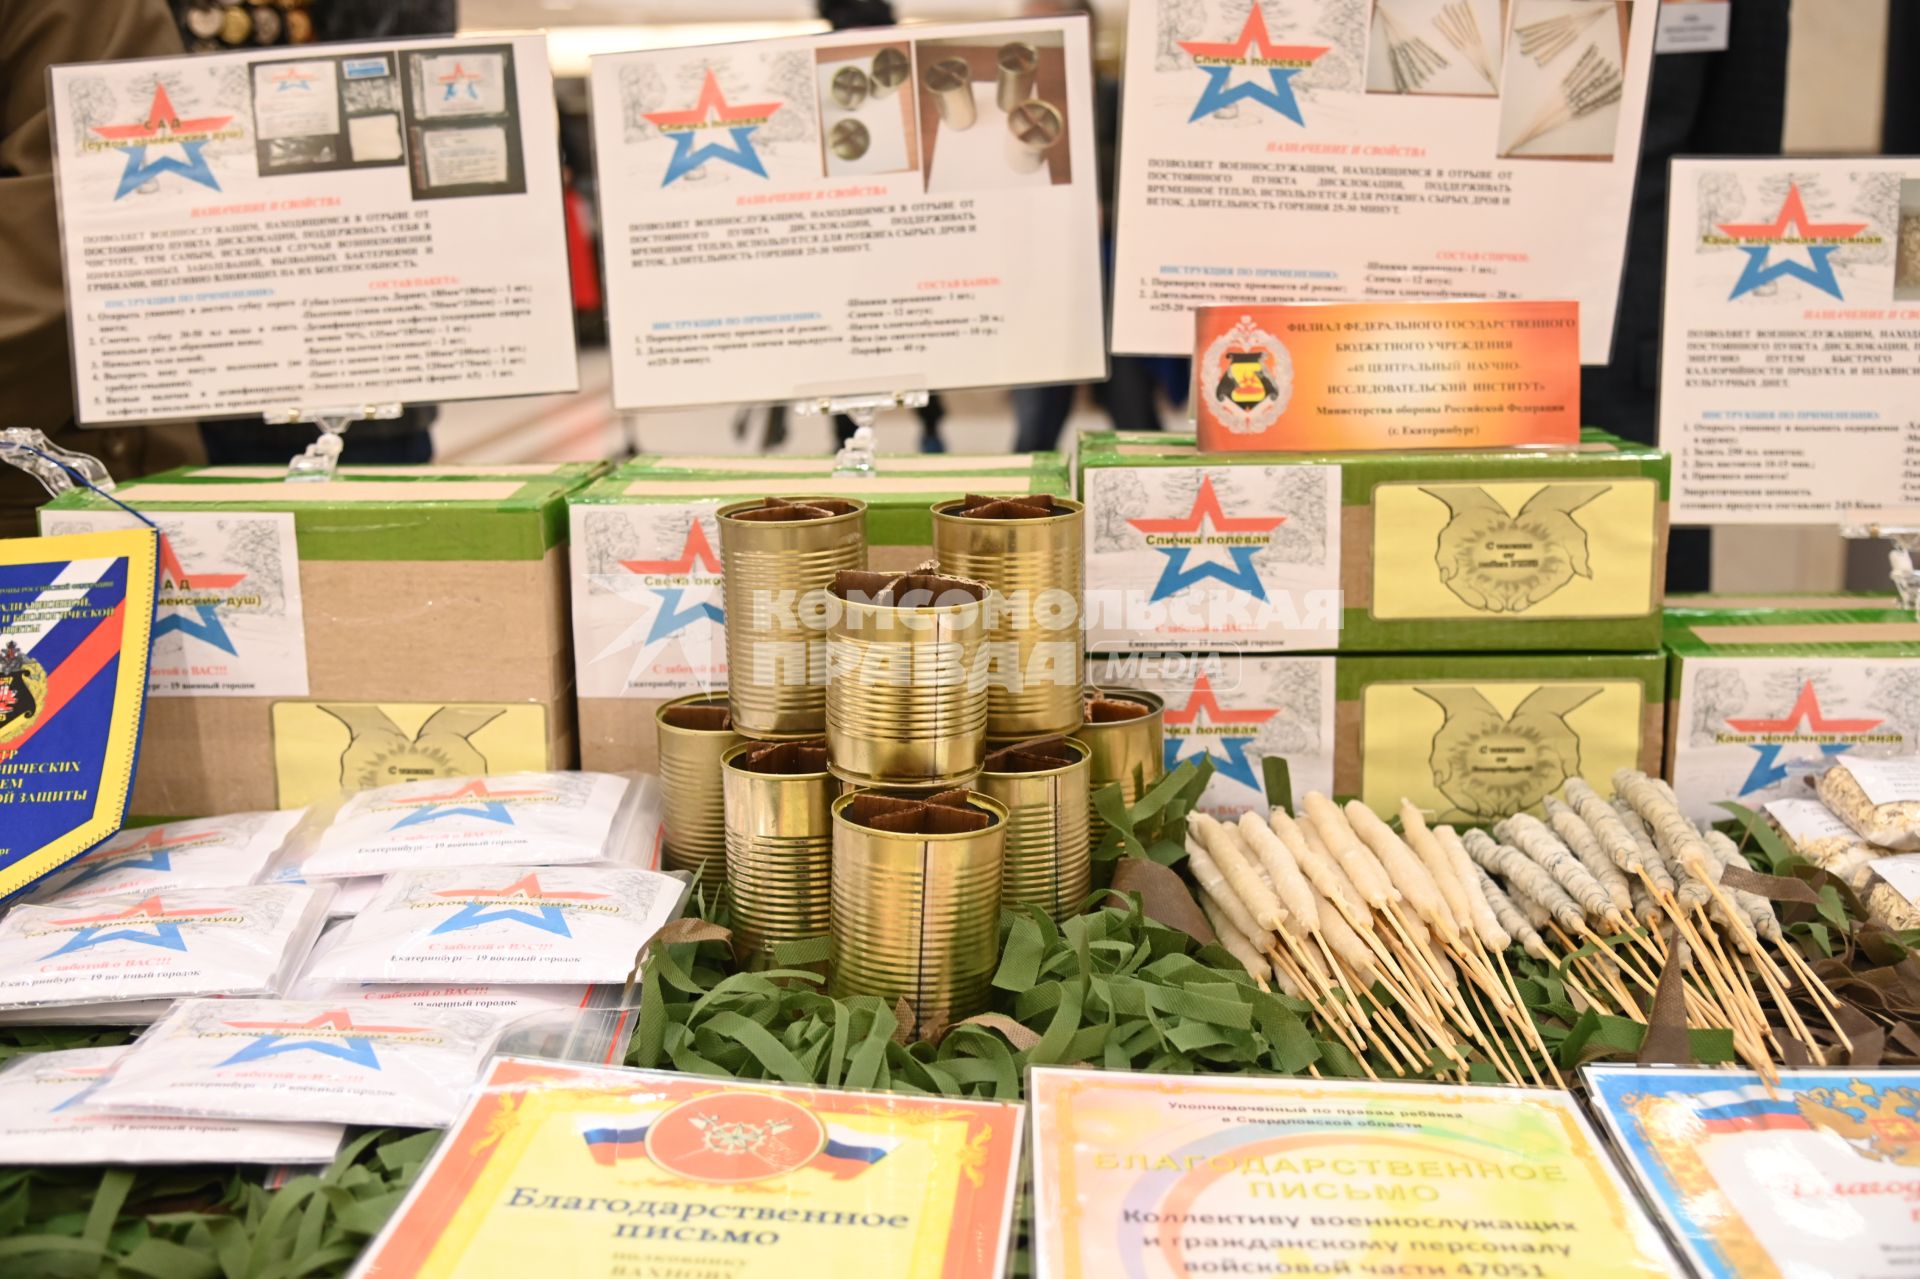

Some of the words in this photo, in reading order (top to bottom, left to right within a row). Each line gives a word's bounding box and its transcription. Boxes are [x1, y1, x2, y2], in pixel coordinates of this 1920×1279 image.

[1193, 53, 1244, 68] Спичка
[1250, 56, 1312, 69] полевая
[1703, 233, 1741, 246] Каша
[1286, 323, 1340, 332] ФИЛИАЛ
[1344, 320, 1443, 332] ФЕДЕРАЛЬНОГО
[1445, 318, 1576, 330] ГОСУДАРСТВЕННОГО
[1335, 342, 1424, 352] БЮДЖЕТНОГО
[1428, 341, 1513, 351] УЧРЕЖДЕНИЯ
[1367, 361, 1461, 373] ЦЕНТРАЛЬНЫЙ
[1466, 361, 1522, 371] НАУЧНО-
[1326, 383, 1467, 394] ИССЛЕДОВАТЕЛЬСКИЙ
[1472, 382, 1546, 393] ИНСТИТУТ»
[1316, 406, 1392, 417] Министерства
[1395, 406, 1441, 416] обороны
[1444, 403, 1504, 414] Российской
[1507, 403, 1565, 414] Федерации
[1401, 426, 1480, 437] Екатеринбург)
[1146, 534, 1201, 546] Спичка
[1206, 534, 1271, 546] полевая
[644, 576, 690, 587] Свеча
[226, 596, 263, 609] душ)
[1129, 639, 1189, 650] Екатеринбург
[1250, 639, 1285, 650] городок
[191, 666, 229, 677] ВАС!!!
[182, 681, 219, 691] военный
[222, 682, 256, 691] городок
[1196, 725, 1259, 735] полевая
[1715, 732, 1756, 744] Каша
[1761, 733, 1836, 744] молочная
[1840, 732, 1904, 744] овсяная
[20, 789, 88, 803] ЗАЩИТЫ
[390, 953, 464, 964] Екатеринбург
[475, 954, 488, 962] 19
[489, 954, 537, 963] военный
[540, 955, 582, 965] городок
[381, 988, 430, 1000] заботой
[445, 986, 490, 996] ВАС!!!
[475, 1000, 518, 1009] городок
[1168, 1102, 1307, 1115] Уполномоченный
[1312, 1106, 1332, 1115] по
[1336, 1107, 1396, 1118] правам
[1236, 1115, 1352, 1128] Свердловской
[1357, 1117, 1423, 1129] области
[1093, 1152, 1569, 1183] БЛАГОДАРСТВЕННОЕ
[1248, 1180, 1441, 1204] ПИСЬМО
[505, 1186, 910, 1229] Благодарственное
[1122, 1210, 1300, 1228] Коллективу
[1311, 1213, 1578, 1234] военнослужащих
[611, 1223, 780, 1247] письмо
[1142, 1236, 1162, 1247] и
[1171, 1235, 1398, 1255] гражданскому
[1409, 1239, 1572, 1258] персоналу
[1183, 1257, 1354, 1277] войсковой
[1359, 1261, 1446, 1278] части
[1456, 1262, 1545, 1279] 47051
